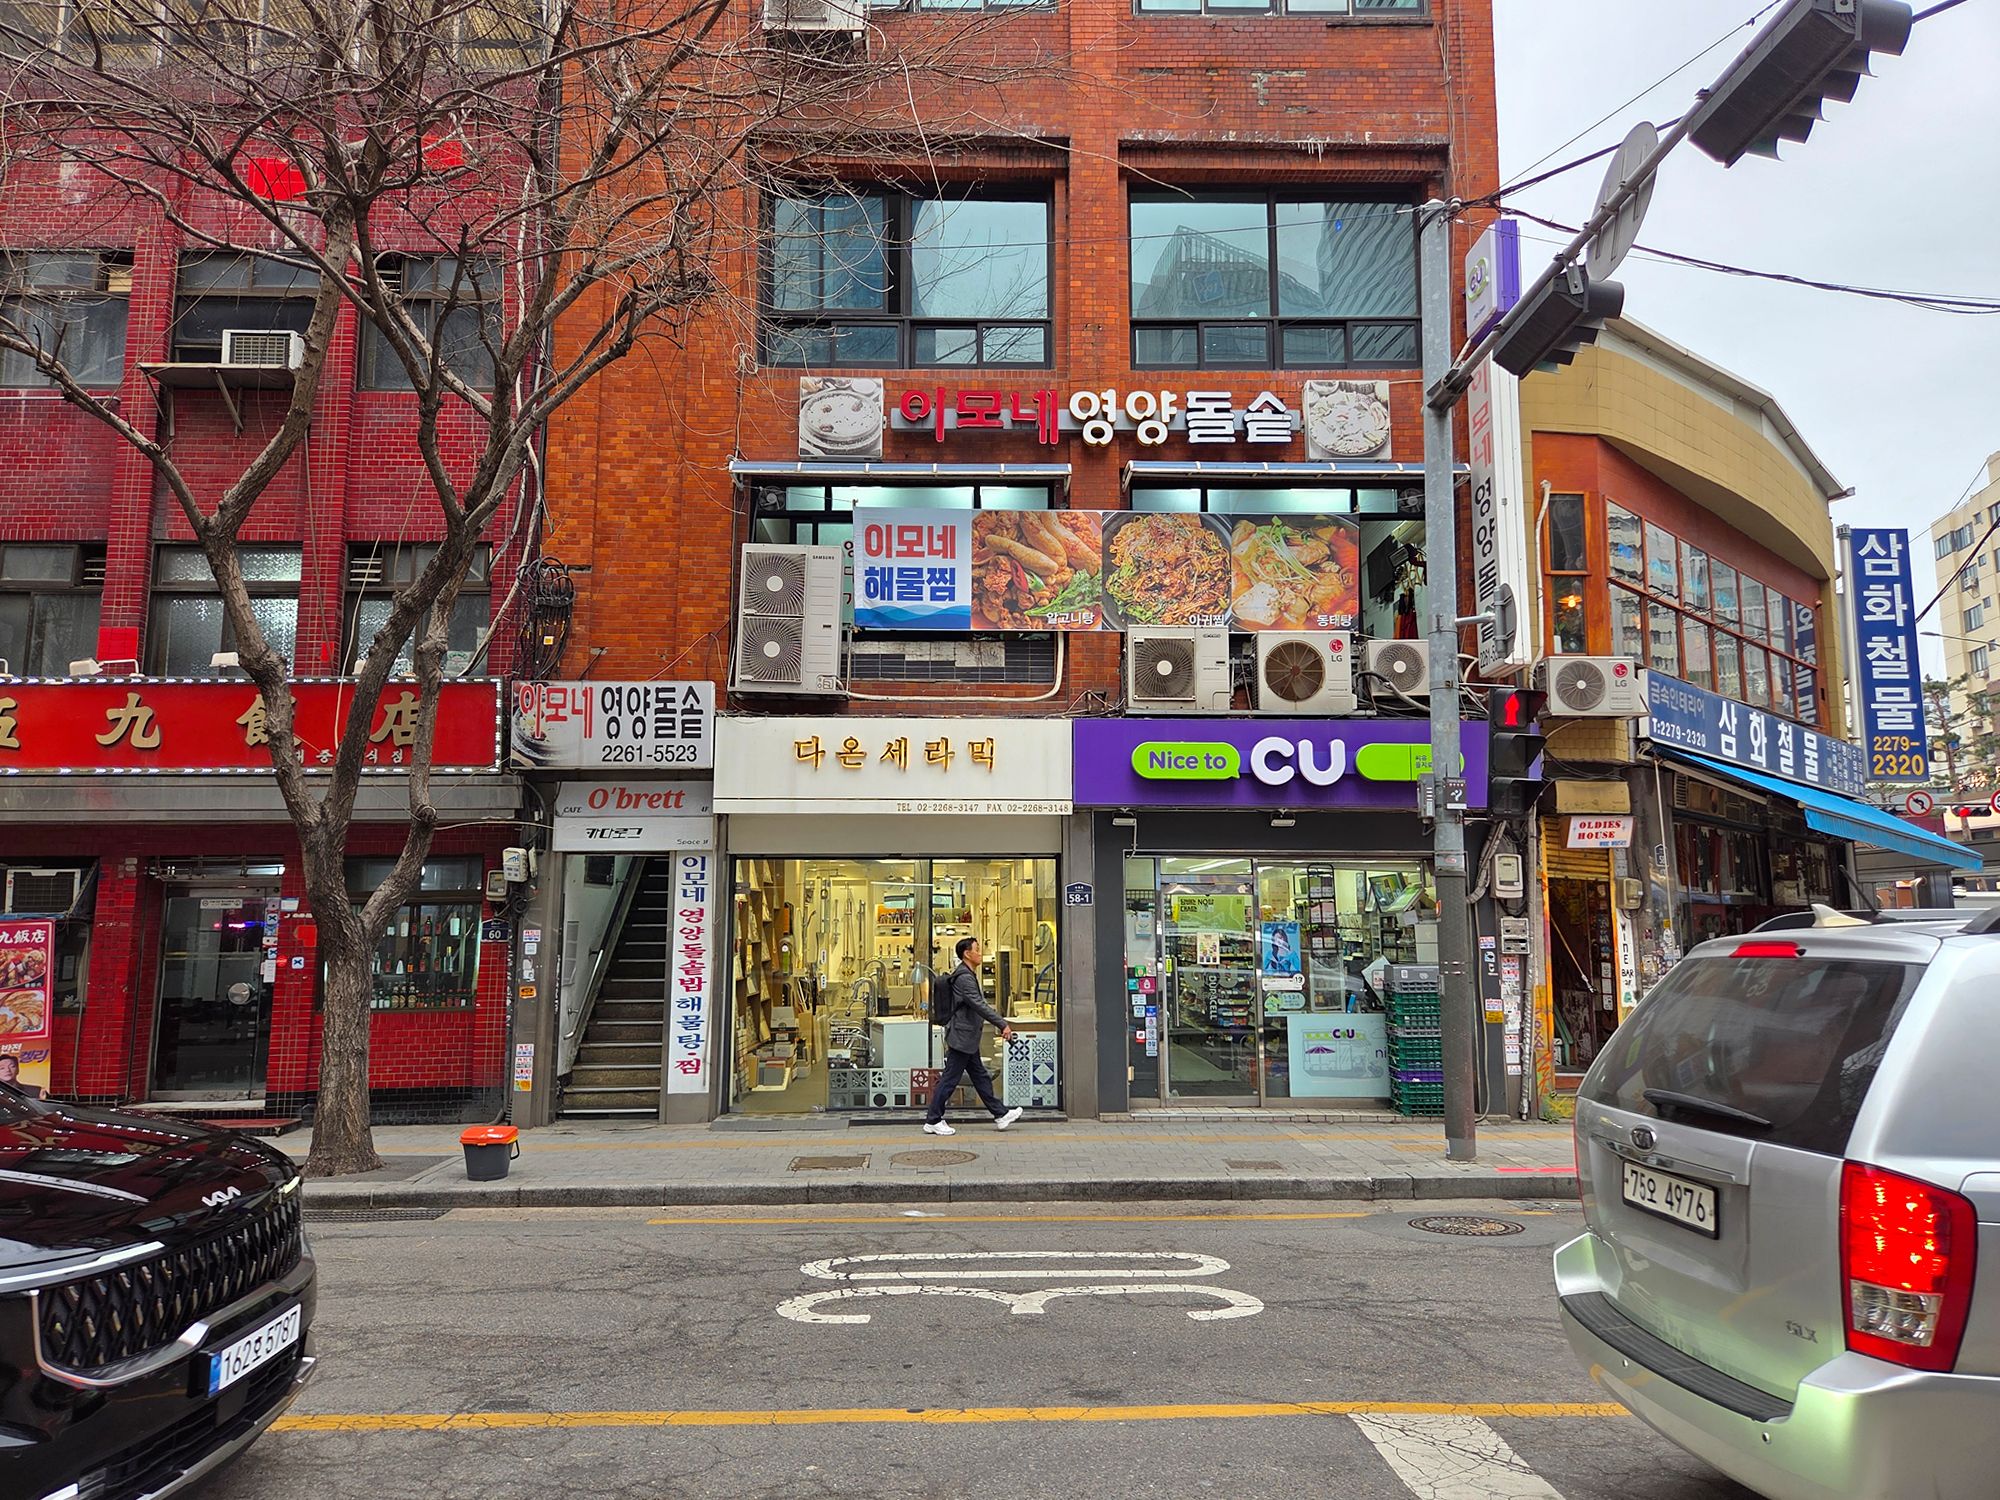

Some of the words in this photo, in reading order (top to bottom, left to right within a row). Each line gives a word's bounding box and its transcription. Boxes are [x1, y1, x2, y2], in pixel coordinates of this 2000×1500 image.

[900, 388, 1060, 445] 이모네
[1070, 387, 1294, 447] 영양돌솥
[864, 524, 957, 560] 이모네
[864, 566, 957, 602] 해물찜
[1046, 611, 1096, 626] 알고니탕
[1188, 613, 1225, 627] 아귀찜
[1316, 613, 1353, 628] 동태탕
[1858, 533, 1918, 732] 삼화철물
[1331, 655, 1343, 663] LG
[1615, 679, 1627, 688] LG
[519, 683, 594, 740] 이모네
[600, 685, 704, 740] 영양돌솥
[1650, 681, 1706, 721] 금속인테리어
[1652, 717, 1707, 749] T:2279-2320
[1718, 700, 1819, 783] 삼화철물
[1873, 735, 1921, 751] 2279-
[601, 745, 698, 763] 2261-5523
[793, 735, 997, 772] 다온세라믹
[1149, 751, 1199, 771] Nice
[1203, 752, 1228, 771] to
[1250, 736, 1346, 786] CU
[1872, 753, 1925, 776] 2320
[563, 806, 583, 814] CAFE
[588, 787, 686, 810] O'brett
[896, 803, 912, 812] TEL
[917, 803, 979, 813] 02-2268-3147
[986, 803, 1003, 813] FAX
[1007, 803, 1069, 813] 02-2268-3148
[585, 827, 644, 839] 카다로그
[1577, 831, 1616, 840] HOUSE
[1579, 820, 1622, 830] OLDIES
[681, 855, 709, 903] 이모네
[1069, 894, 1089, 903] 58-1
[488, 930, 502, 940] 60
[677, 907, 707, 993] 영양돌솥밥
[1208, 974, 1218, 1021] DURACELL
[1630, 1169, 1657, 1204] 75오
[1665, 1181, 1706, 1222] 4976
[265, 1310, 298, 1355] 5787
